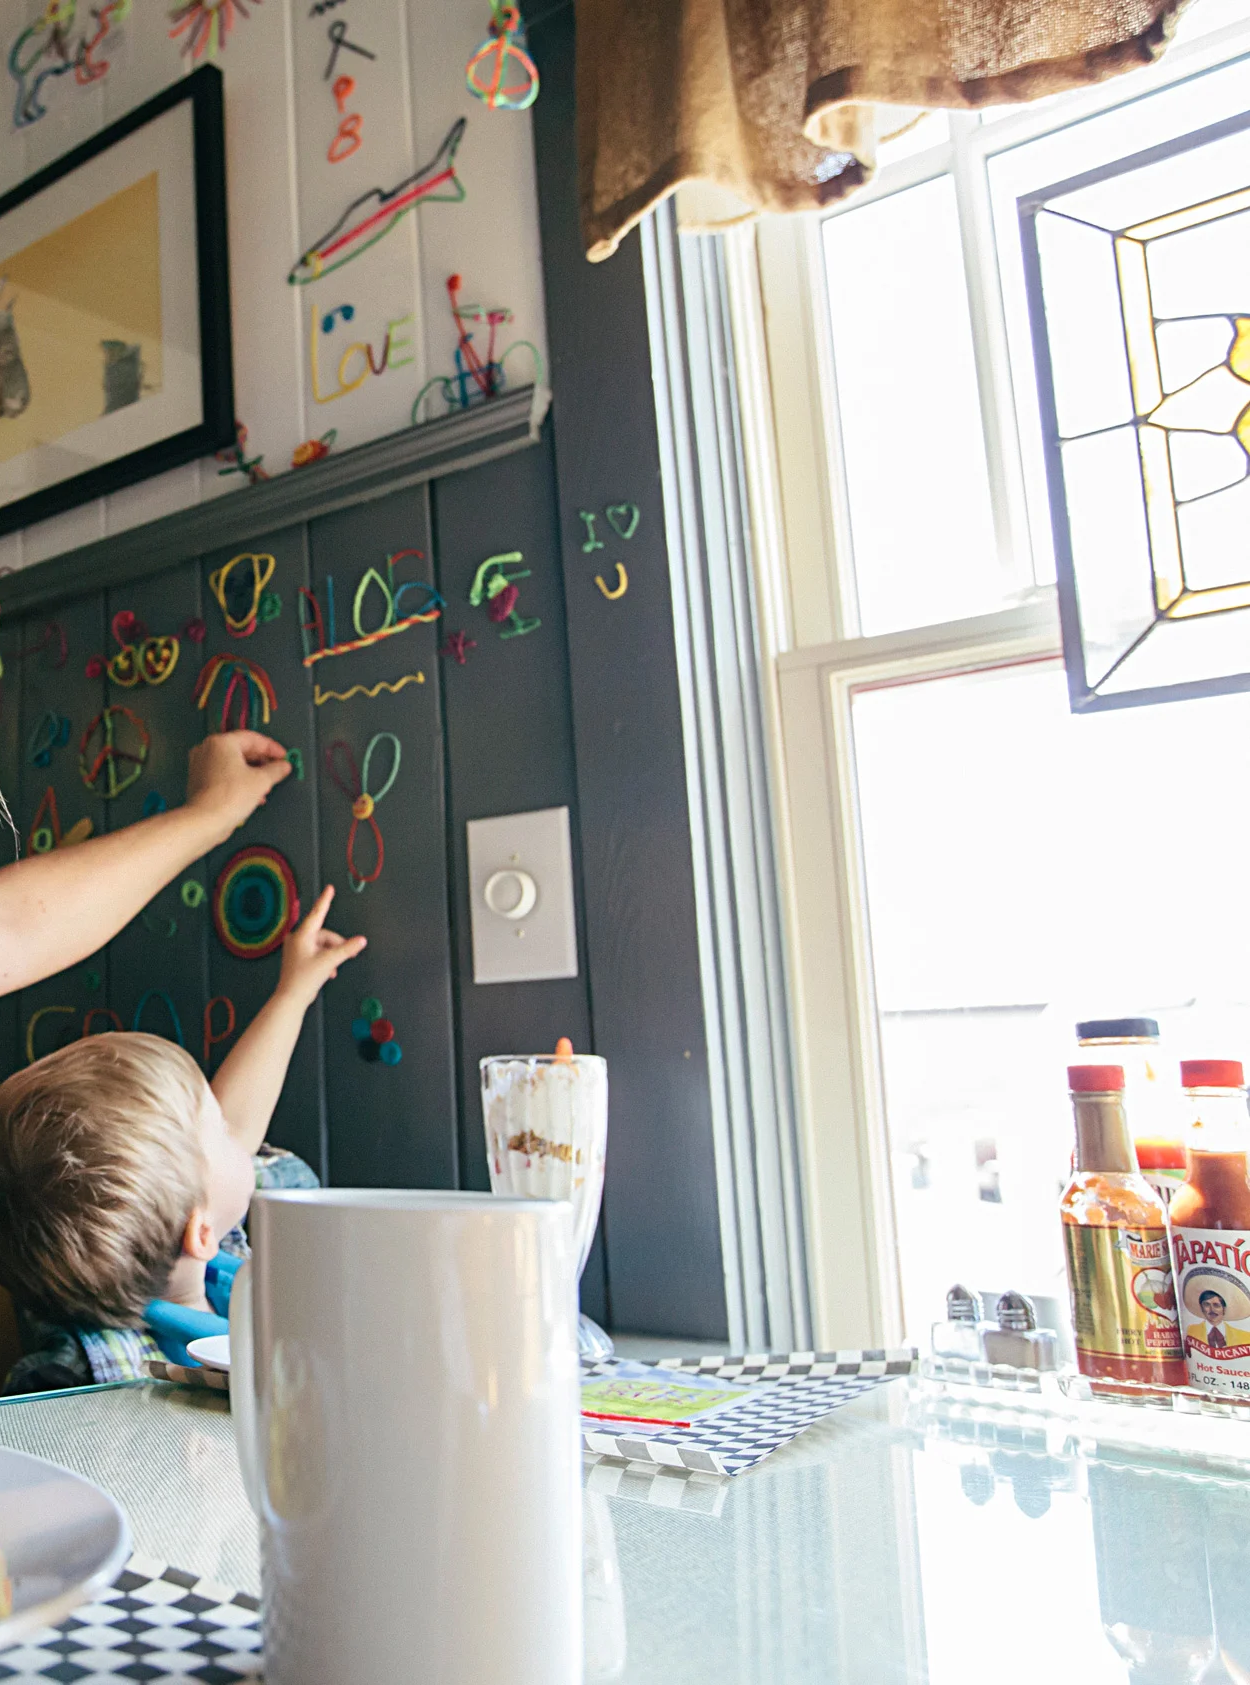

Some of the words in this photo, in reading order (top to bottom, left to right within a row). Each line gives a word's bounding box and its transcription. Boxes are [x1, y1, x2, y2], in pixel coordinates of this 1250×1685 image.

[311, 304, 416, 403] LOVE
[1129, 1242, 1161, 1259] MARIE
[1187, 1337, 1211, 1356] SALSA
[1197, 1362, 1214, 1373] Hot
[1216, 1366, 1250, 1378] Sauce
